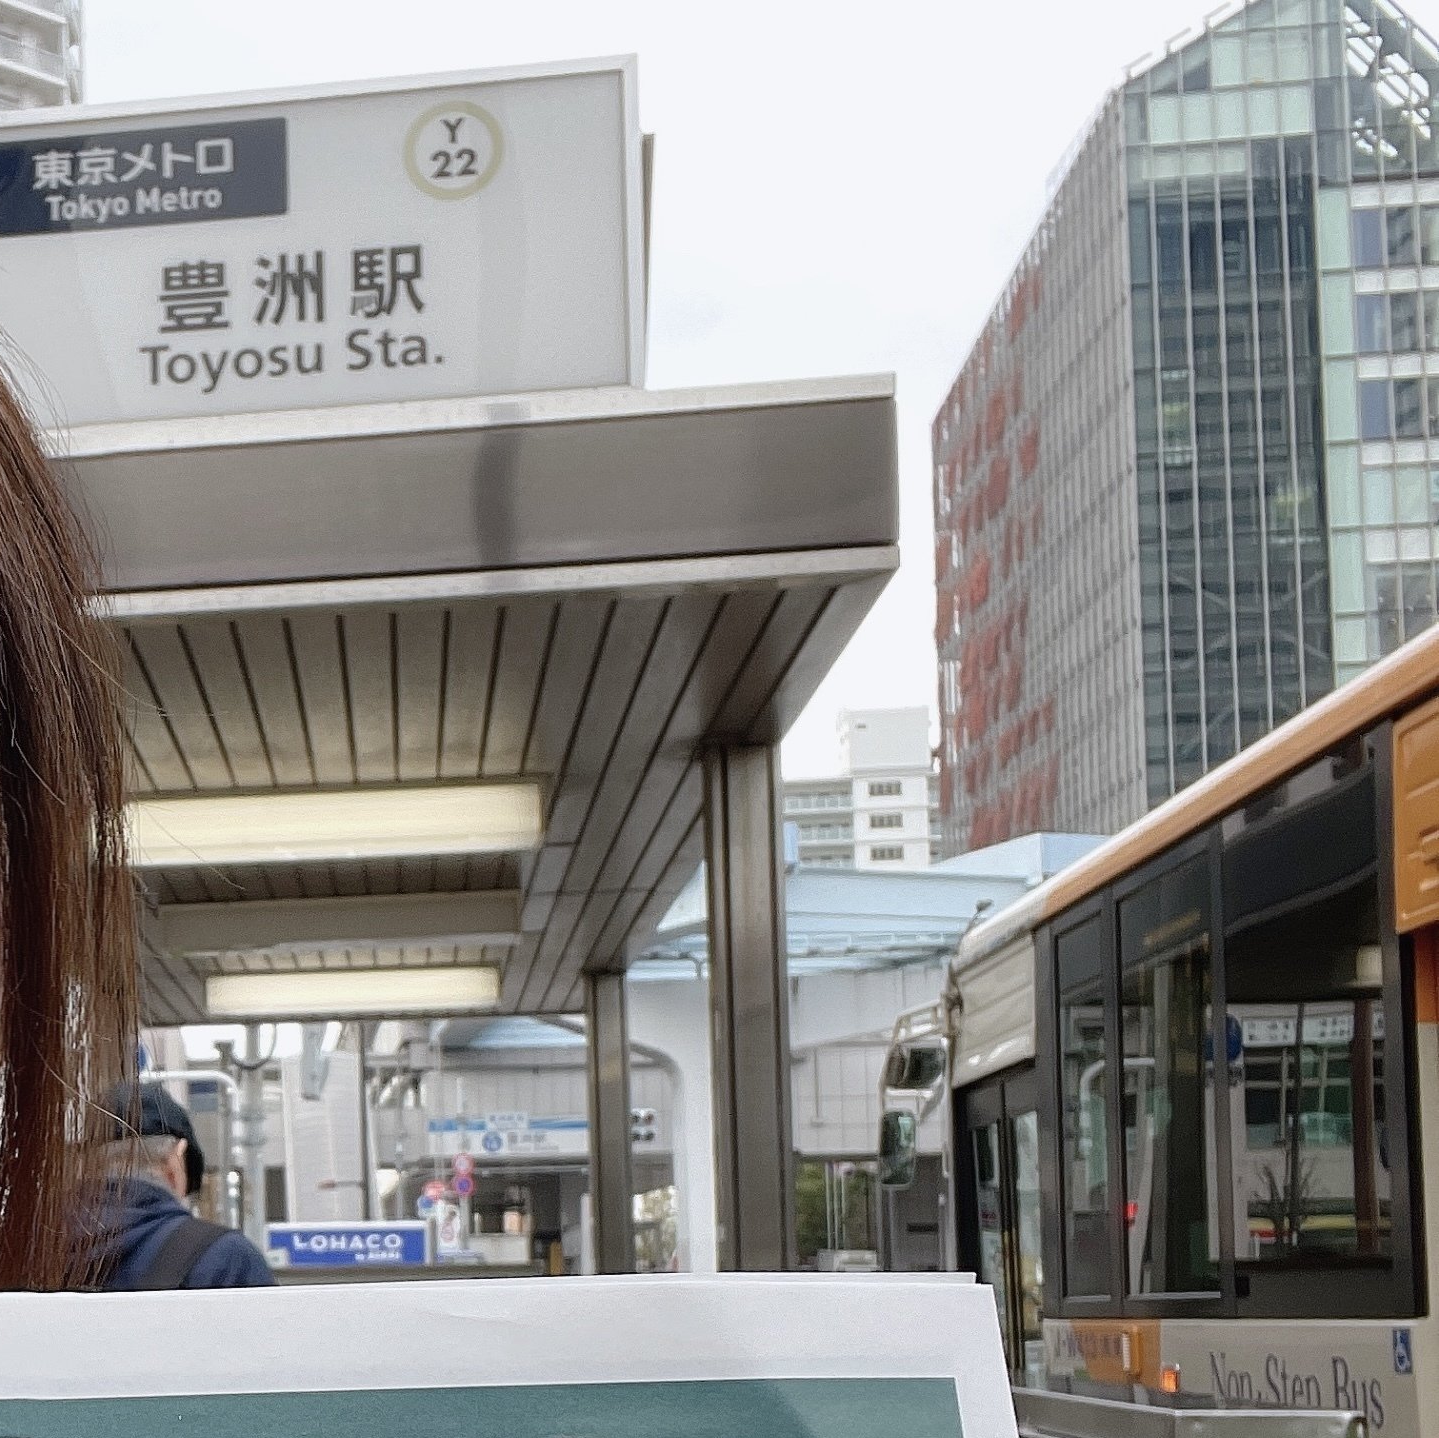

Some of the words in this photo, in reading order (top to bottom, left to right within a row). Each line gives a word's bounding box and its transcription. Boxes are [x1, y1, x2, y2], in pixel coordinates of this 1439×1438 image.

[440, 118, 466, 145] Y
[32, 137, 234, 191] 東京メトロ
[430, 148, 480, 179] 22
[45, 192, 131, 224] Tokyo
[135, 186, 223, 215] Metro
[158, 244, 426, 334] 豊洲駅
[139, 343, 324, 394] Toyosu
[346, 327, 445, 371] Sta.
[292, 1233, 403, 1253] LOHACO
[1332, 1354, 1385, 1430] Bus
